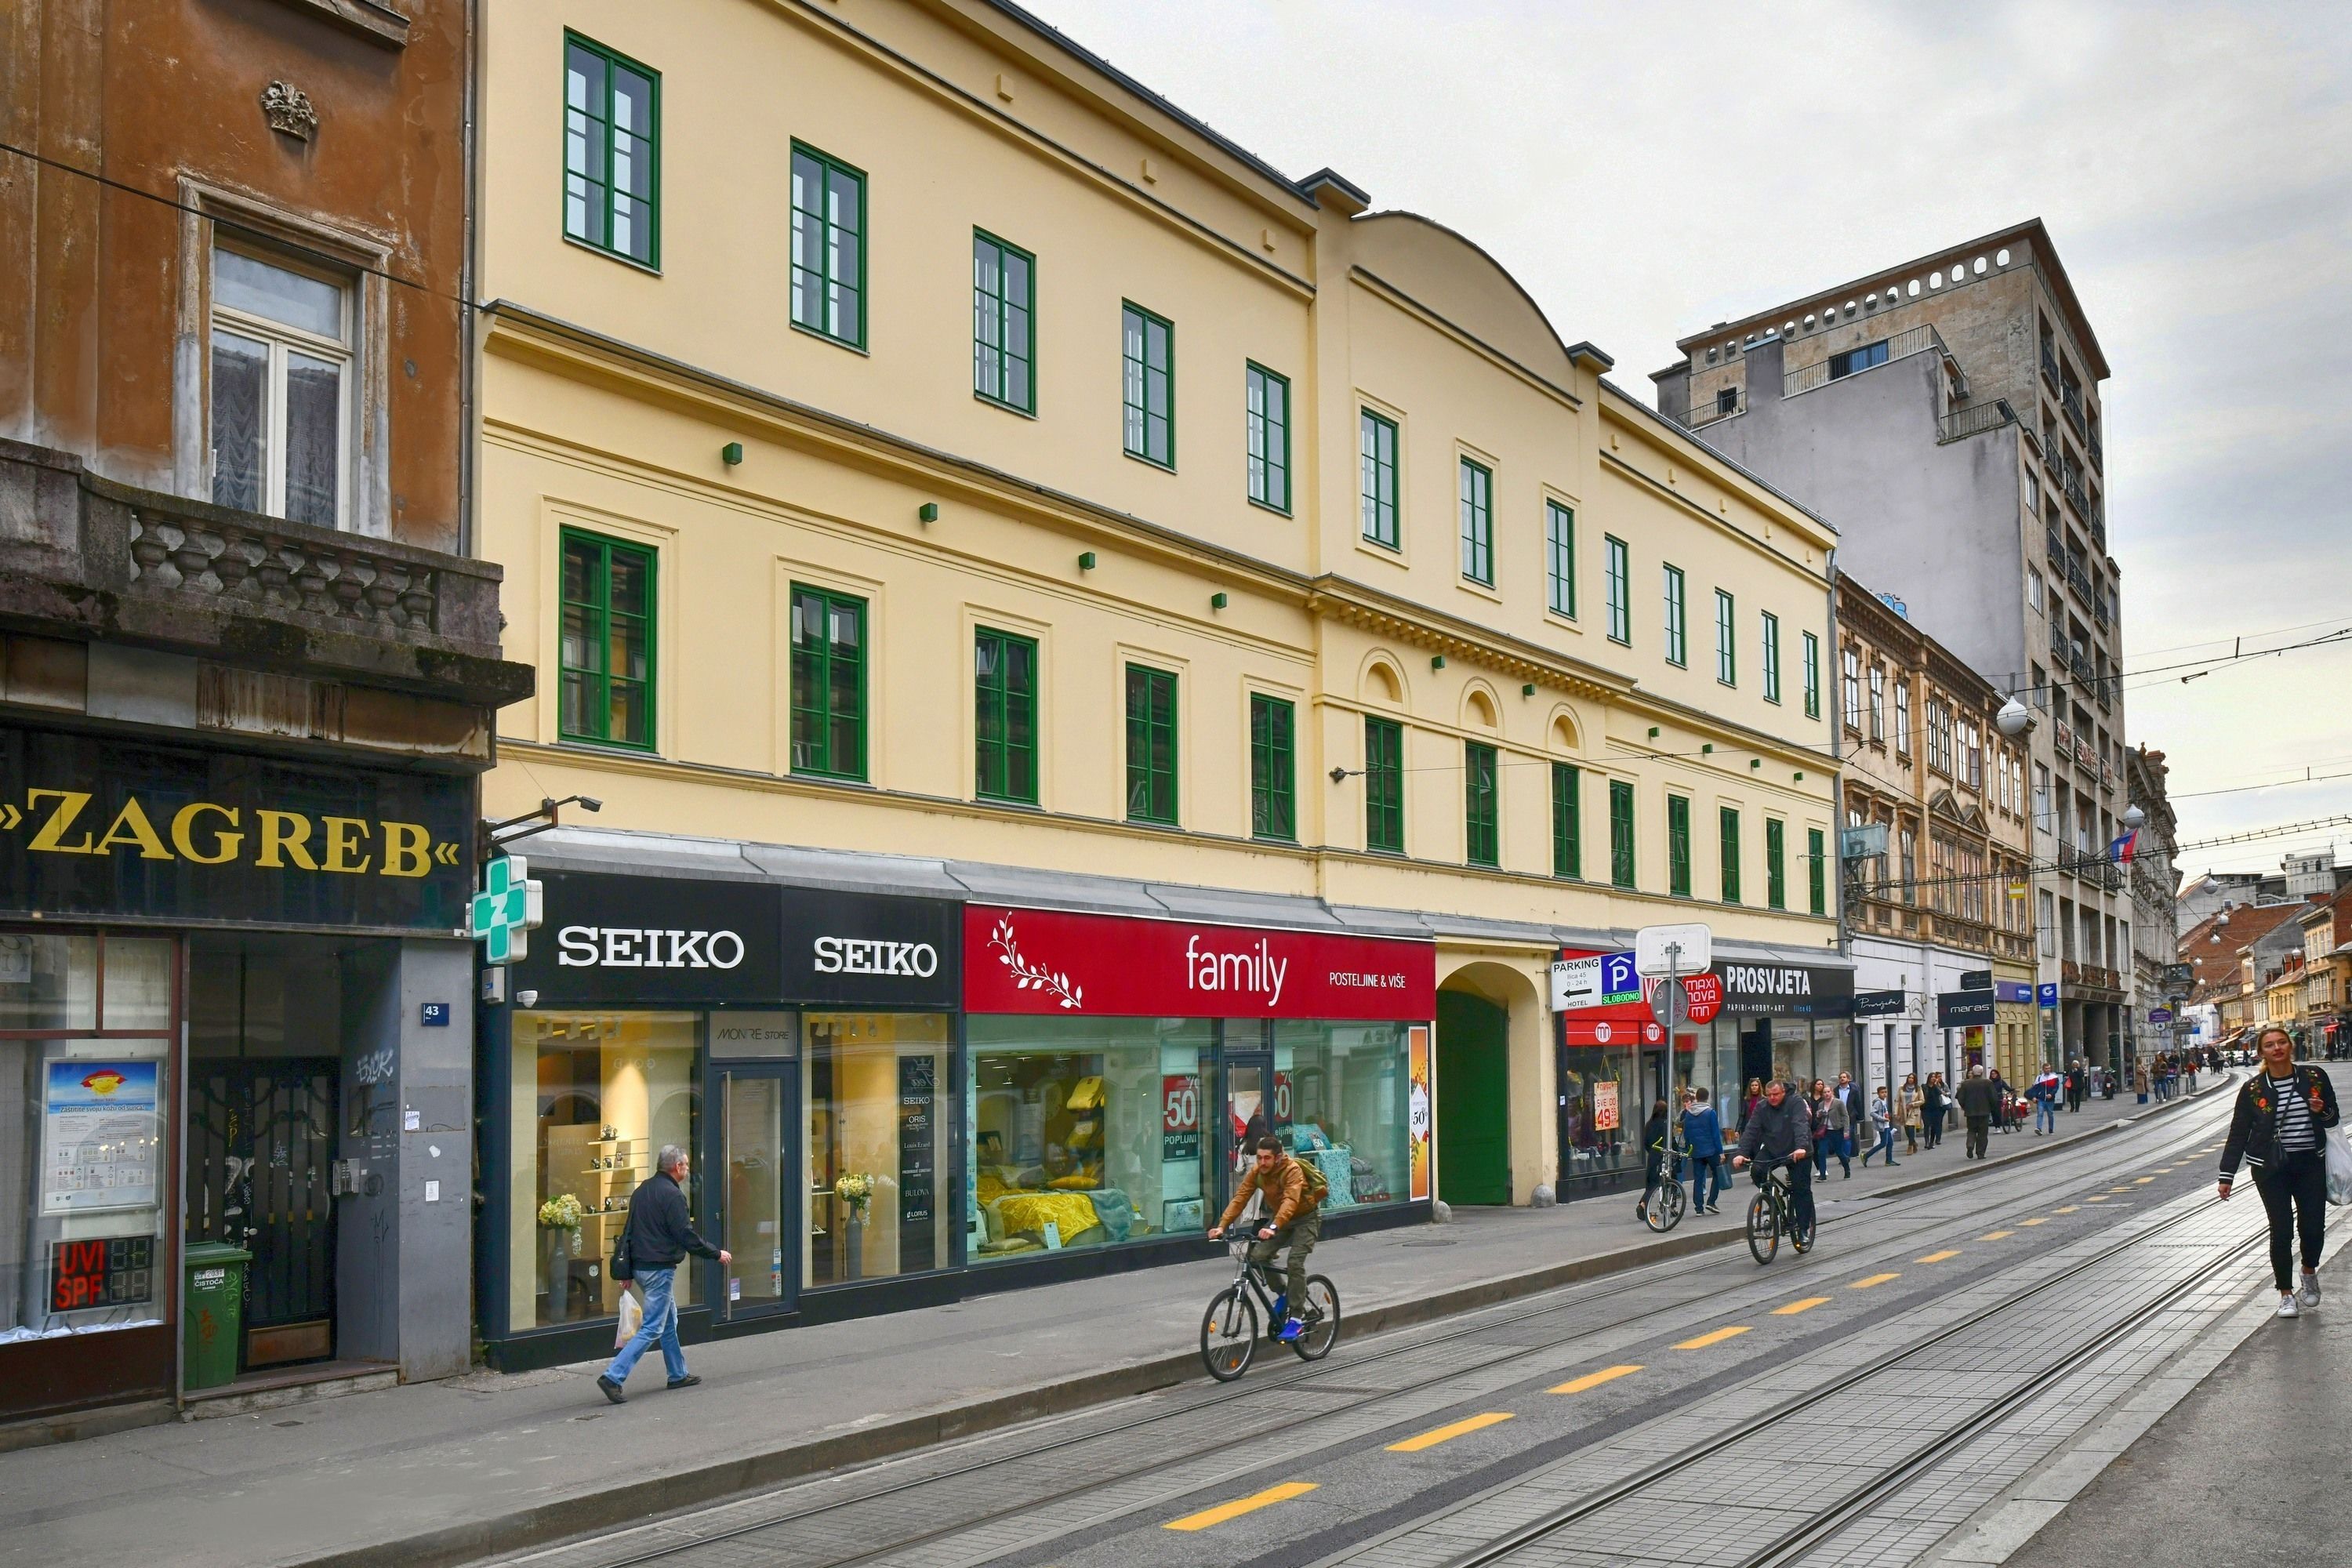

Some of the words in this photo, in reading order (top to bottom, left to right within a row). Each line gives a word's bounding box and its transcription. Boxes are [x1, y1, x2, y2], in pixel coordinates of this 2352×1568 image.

[557, 926, 745, 969] SEIKO
[814, 936, 938, 978] SEIKO
[1186, 935, 1287, 1007] family
[1554, 959, 1599, 972] PARKING
[1330, 972, 1378, 988] POSTELJINE
[1380, 975, 1387, 988] &
[1388, 972, 1406, 988] VIŠE
[1726, 966, 1811, 995] PROSVJETA
[1602, 992, 1639, 1004] SLOBODNO
[426, 1006, 439, 1016] 43
[1950, 1004, 1990, 1014] maras
[764, 1031, 789, 1040] STORE
[1597, 1108, 1611, 1127] 49
[1275, 1127, 1293, 1137] eljine
[1164, 1134, 1197, 1145] POPLUNI
[905, 1189, 929, 1197] BULOVA
[60, 1240, 105, 1276] UVI
[194, 1278, 223, 1287] ČISTOĆA
[55, 1273, 103, 1308] SPF
